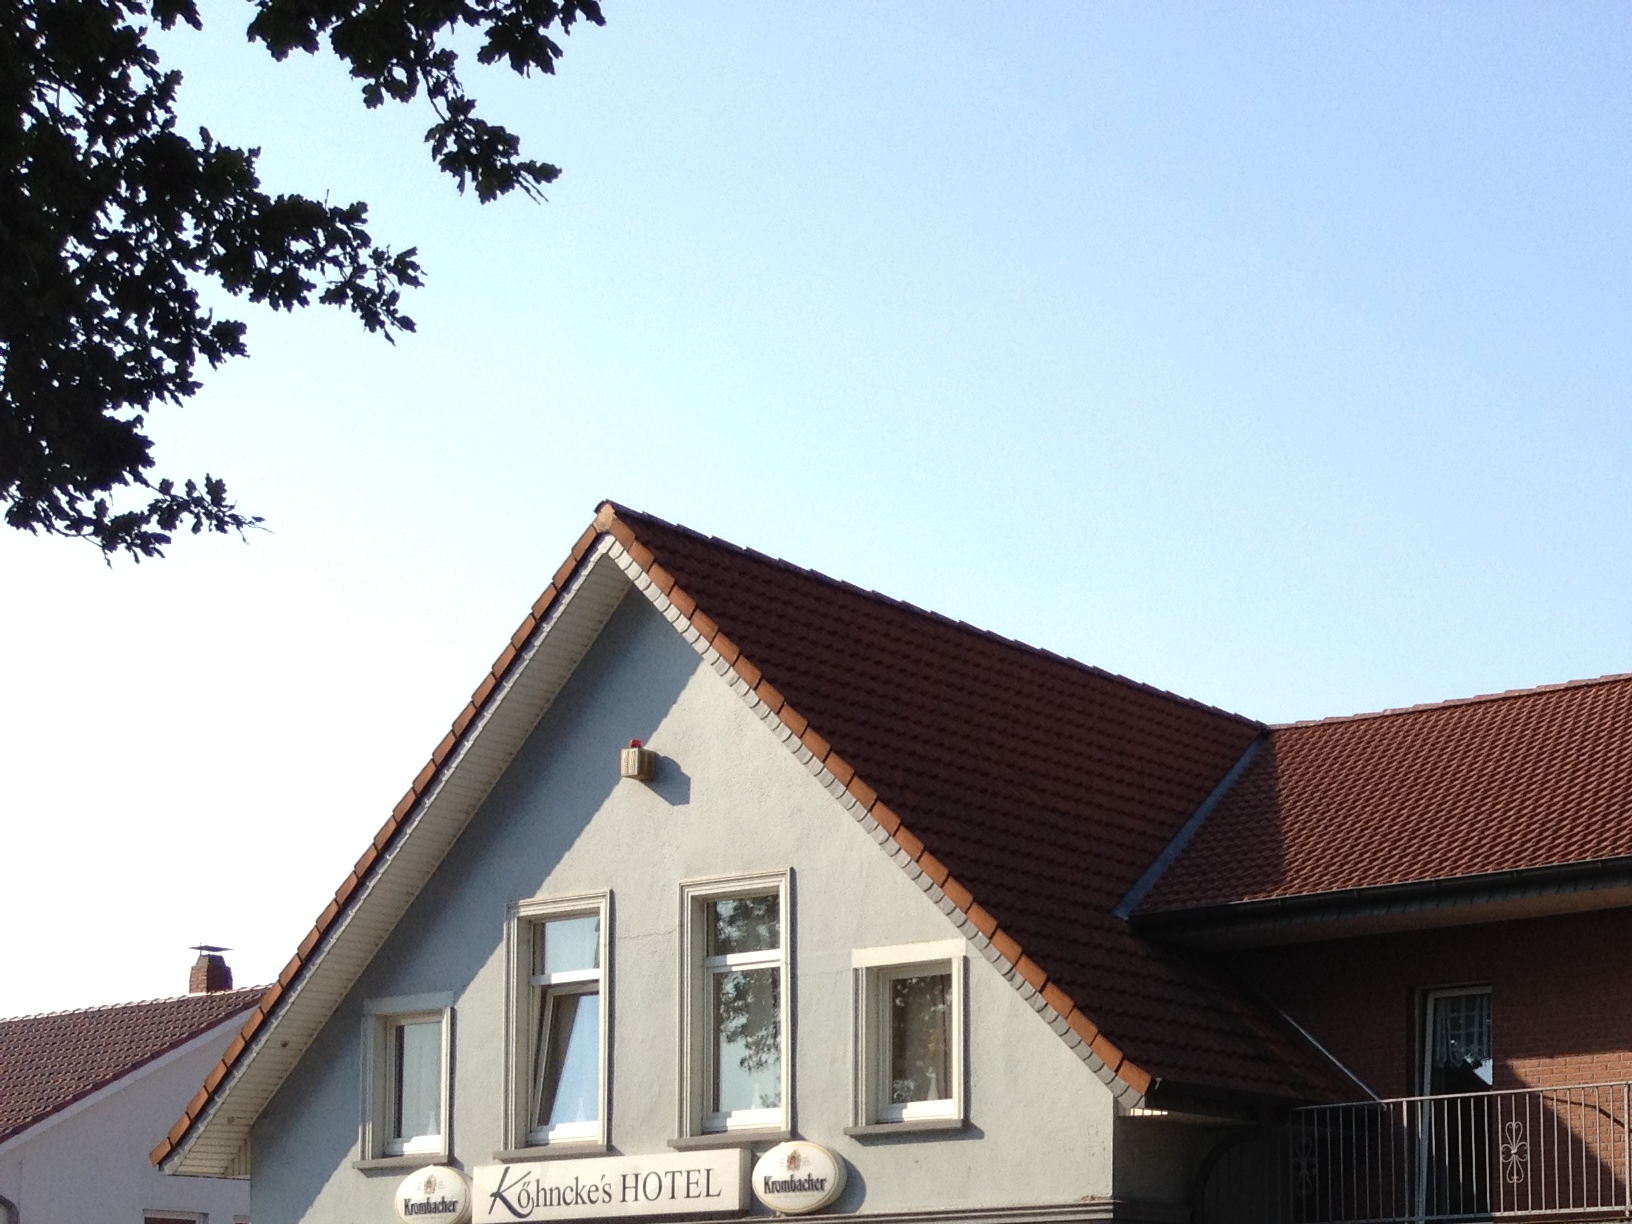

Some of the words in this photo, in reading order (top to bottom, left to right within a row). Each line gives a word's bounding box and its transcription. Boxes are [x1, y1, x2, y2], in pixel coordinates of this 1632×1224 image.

[488, 1165, 613, 1219] Köhncke's
[619, 1168, 723, 1203] HOTEL
[763, 1173, 827, 1194] Krombacher
[404, 1196, 459, 1216] Krombacher
